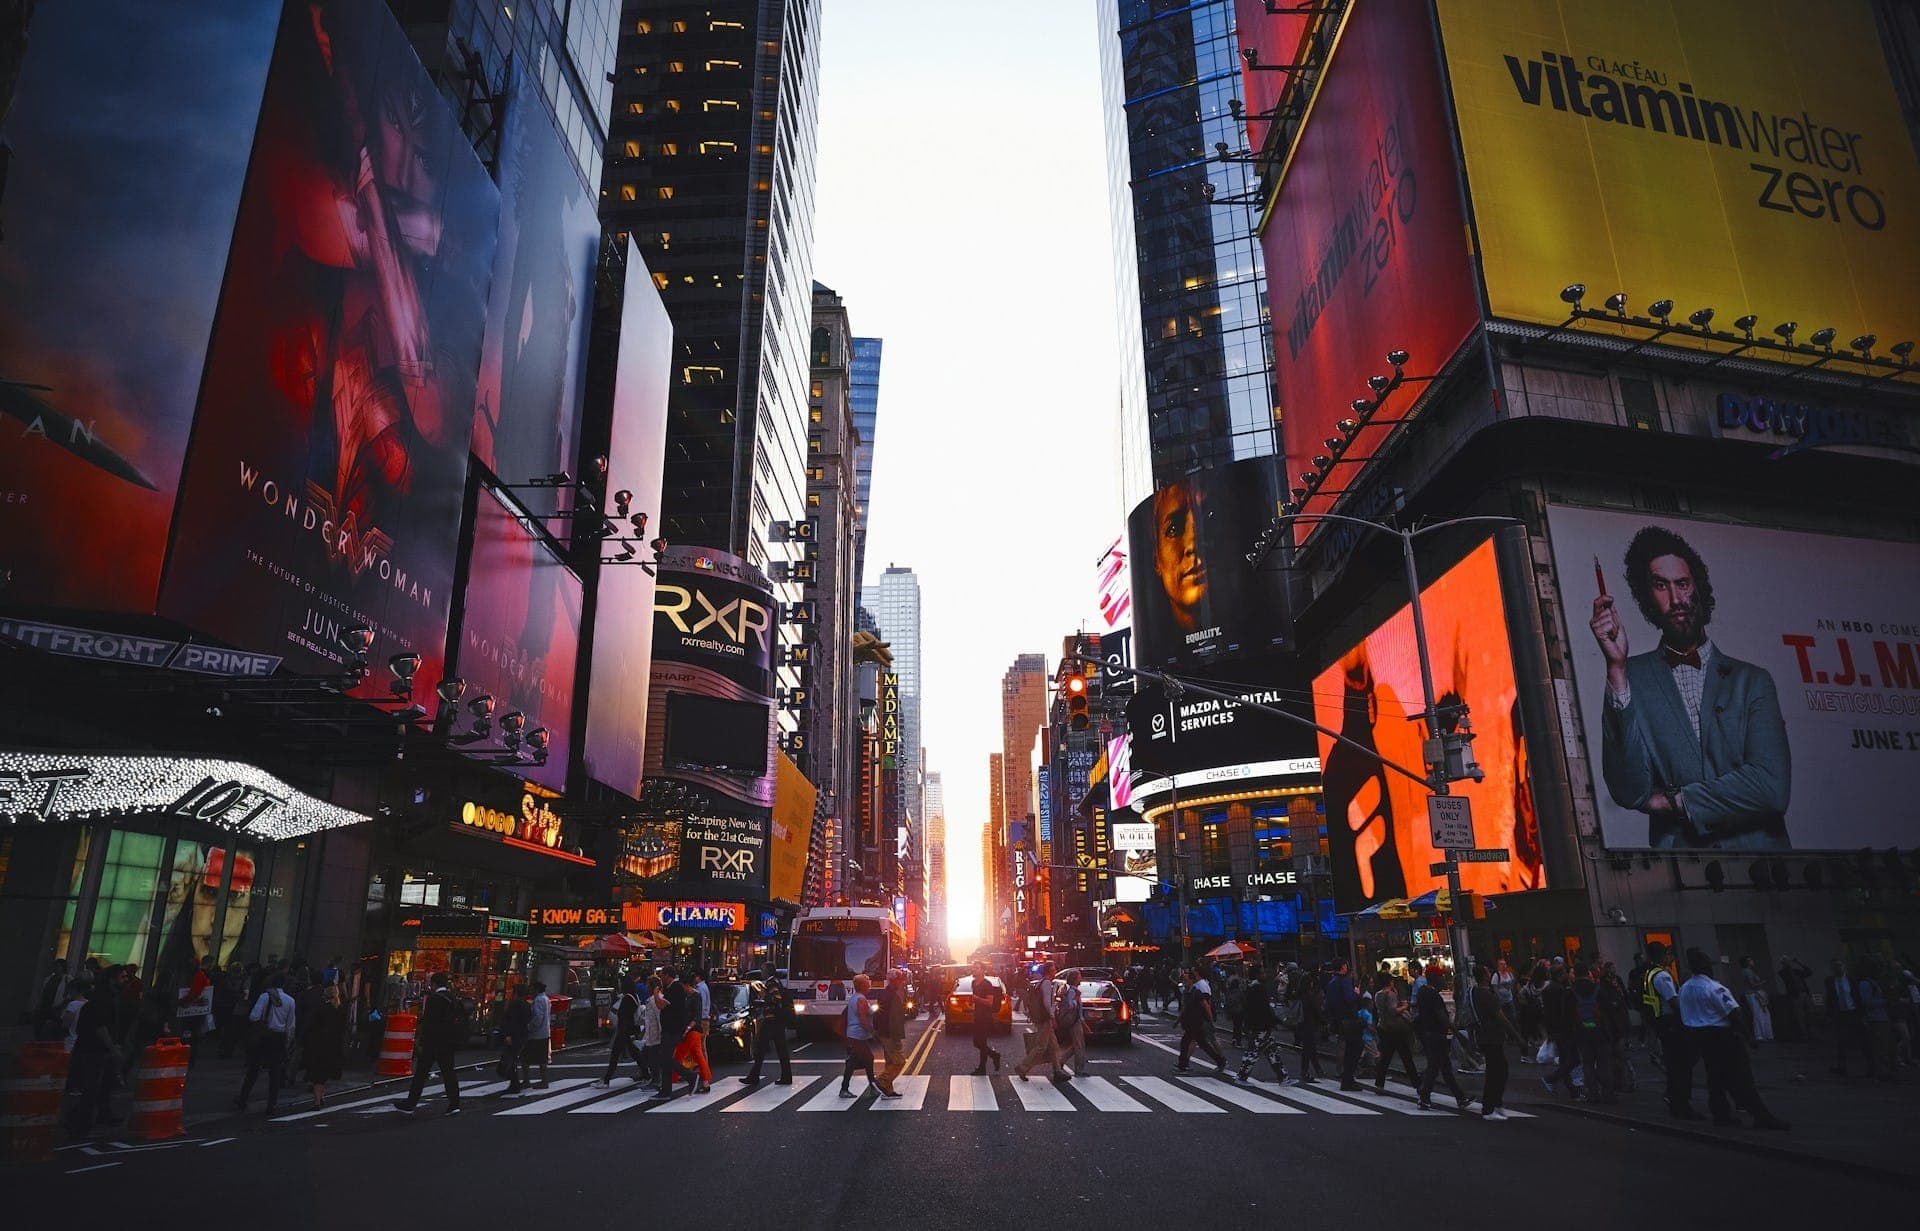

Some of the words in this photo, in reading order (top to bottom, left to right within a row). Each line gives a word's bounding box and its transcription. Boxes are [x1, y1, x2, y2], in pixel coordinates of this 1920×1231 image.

[1503, 50, 1863, 176] vitaminwater
[1749, 162, 1887, 232] zero
[1360, 167, 1417, 298] zero
[1720, 393, 1809, 437] DOW
[239, 459, 352, 555] WONDER
[363, 545, 432, 609] WOMAN
[247, 549, 264, 567] THE
[268, 560, 301, 587] FUTURE
[304, 582, 317, 594] OF
[319, 592, 350, 615] JUSTICE
[302, 608, 338, 643] JUN
[654, 584, 768, 654] RXR
[1816, 620, 1836, 631] AN
[1841, 621, 1874, 633] HBO
[470, 629, 524, 680] WONDER
[681, 635, 746, 656] rxrrealty.com
[185, 649, 269, 675] PRIME
[883, 673, 898, 755] MADAME
[1180, 699, 1221, 718] MAZDA
[1181, 711, 1235, 732] SERVICES
[1851, 729, 1903, 751] JUNE
[1206, 769, 1240, 780] CHASE
[1436, 800, 1462, 810] BUSES
[1440, 811, 1460, 821] ONLY
[728, 817, 747, 830] New
[746, 819, 762, 832] York
[1094, 807, 1107, 853] VICTORY
[686, 828, 702, 841] for
[703, 829, 720, 842] the
[720, 831, 738, 845] 21st
[737, 832, 764, 850] Century
[700, 846, 755, 874] RXR
[1469, 850, 1507, 861] Broadway
[711, 870, 747, 881] REALTY
[1015, 851, 1026, 913] REGAL
[1193, 875, 1232, 890] CHASE
[1247, 871, 1298, 886] CHASE
[542, 908, 581, 925] KNOW
[658, 906, 736, 926] CHAMPS
[1414, 930, 1440, 944] SODA
